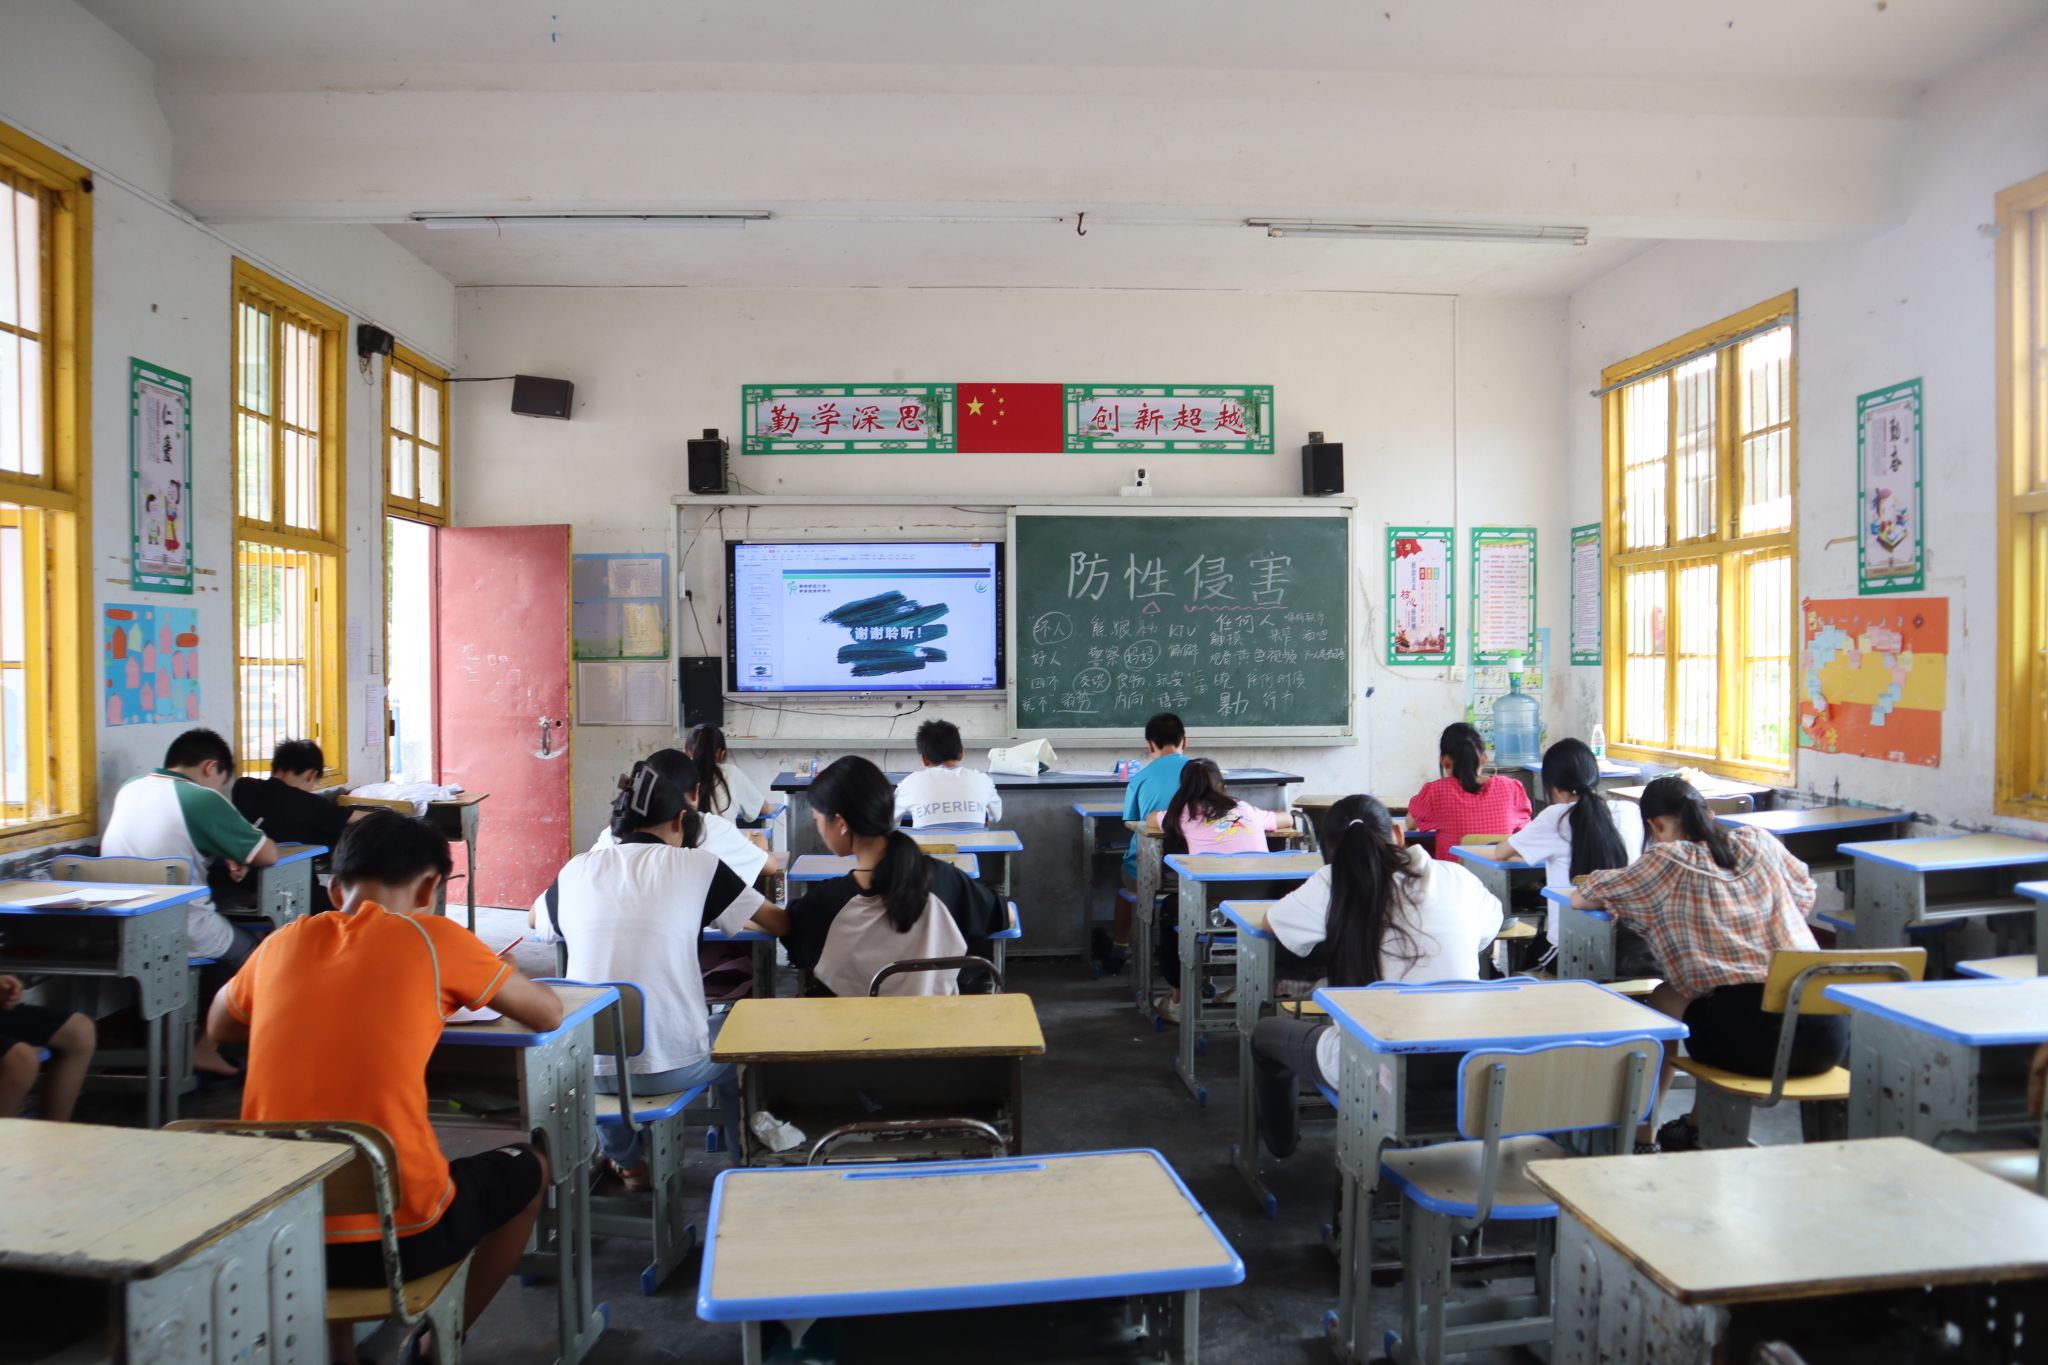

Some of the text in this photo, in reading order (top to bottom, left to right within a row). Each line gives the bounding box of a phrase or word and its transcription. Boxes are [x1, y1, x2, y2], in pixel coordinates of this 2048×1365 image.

[769, 402, 926, 435] 勤学深思
[1090, 403, 1248, 436] 创新超越
[1067, 550, 1292, 605] 防性侵害
[854, 626, 923, 641] 谢谢聆听！
[1215, 612, 1275, 634] 任何人
[1031, 648, 1061, 667] 好人
[1216, 689, 1250, 717] 暴力
